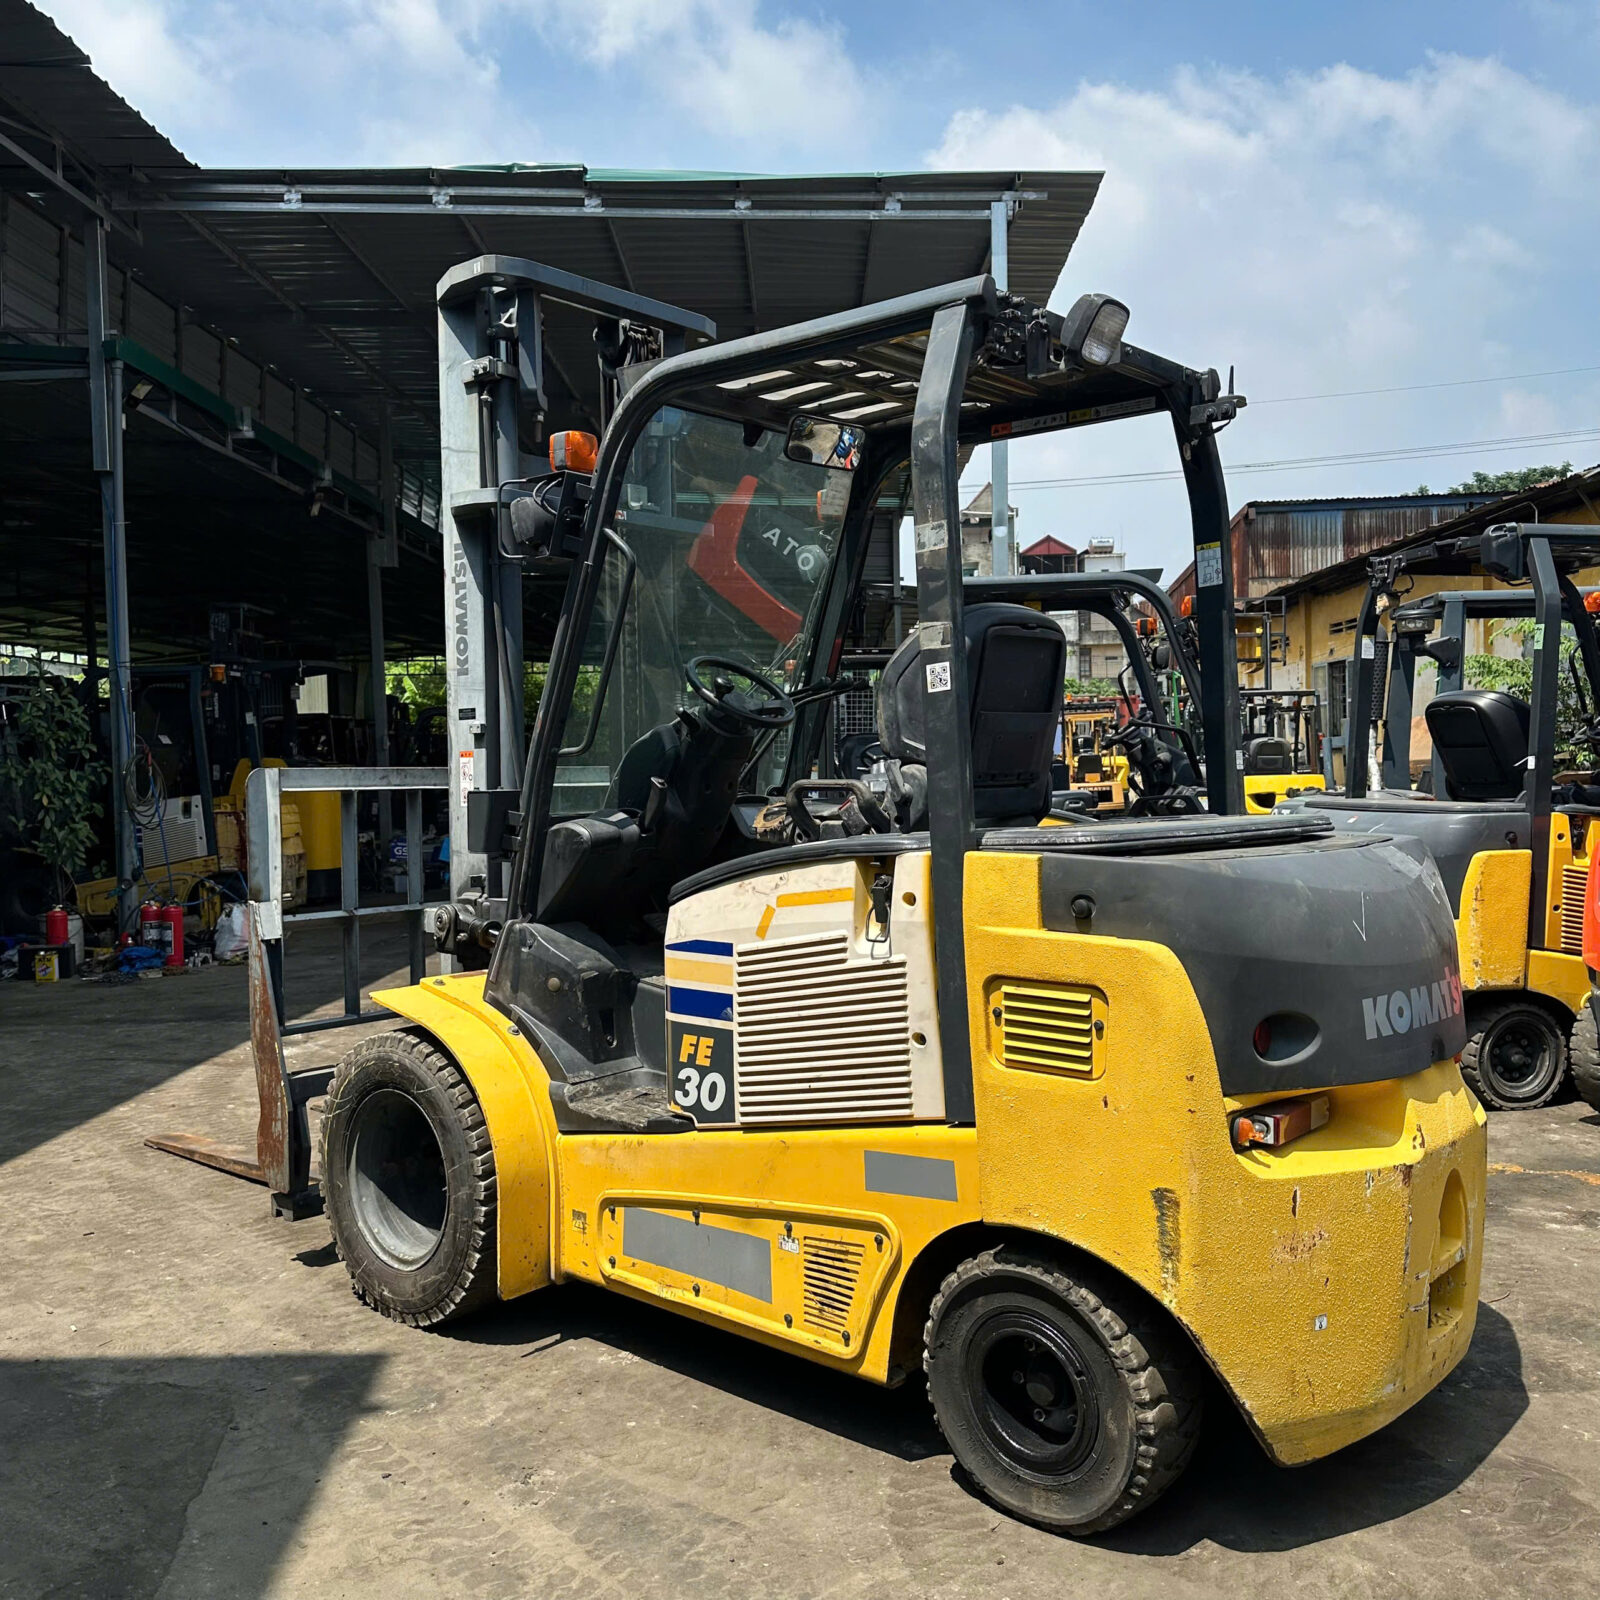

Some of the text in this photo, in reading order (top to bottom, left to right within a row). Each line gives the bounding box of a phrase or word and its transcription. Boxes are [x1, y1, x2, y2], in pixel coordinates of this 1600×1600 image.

[1361, 966, 1461, 1041] KOMATS
[678, 1033, 715, 1067] FE
[674, 1067, 727, 1112] 30
